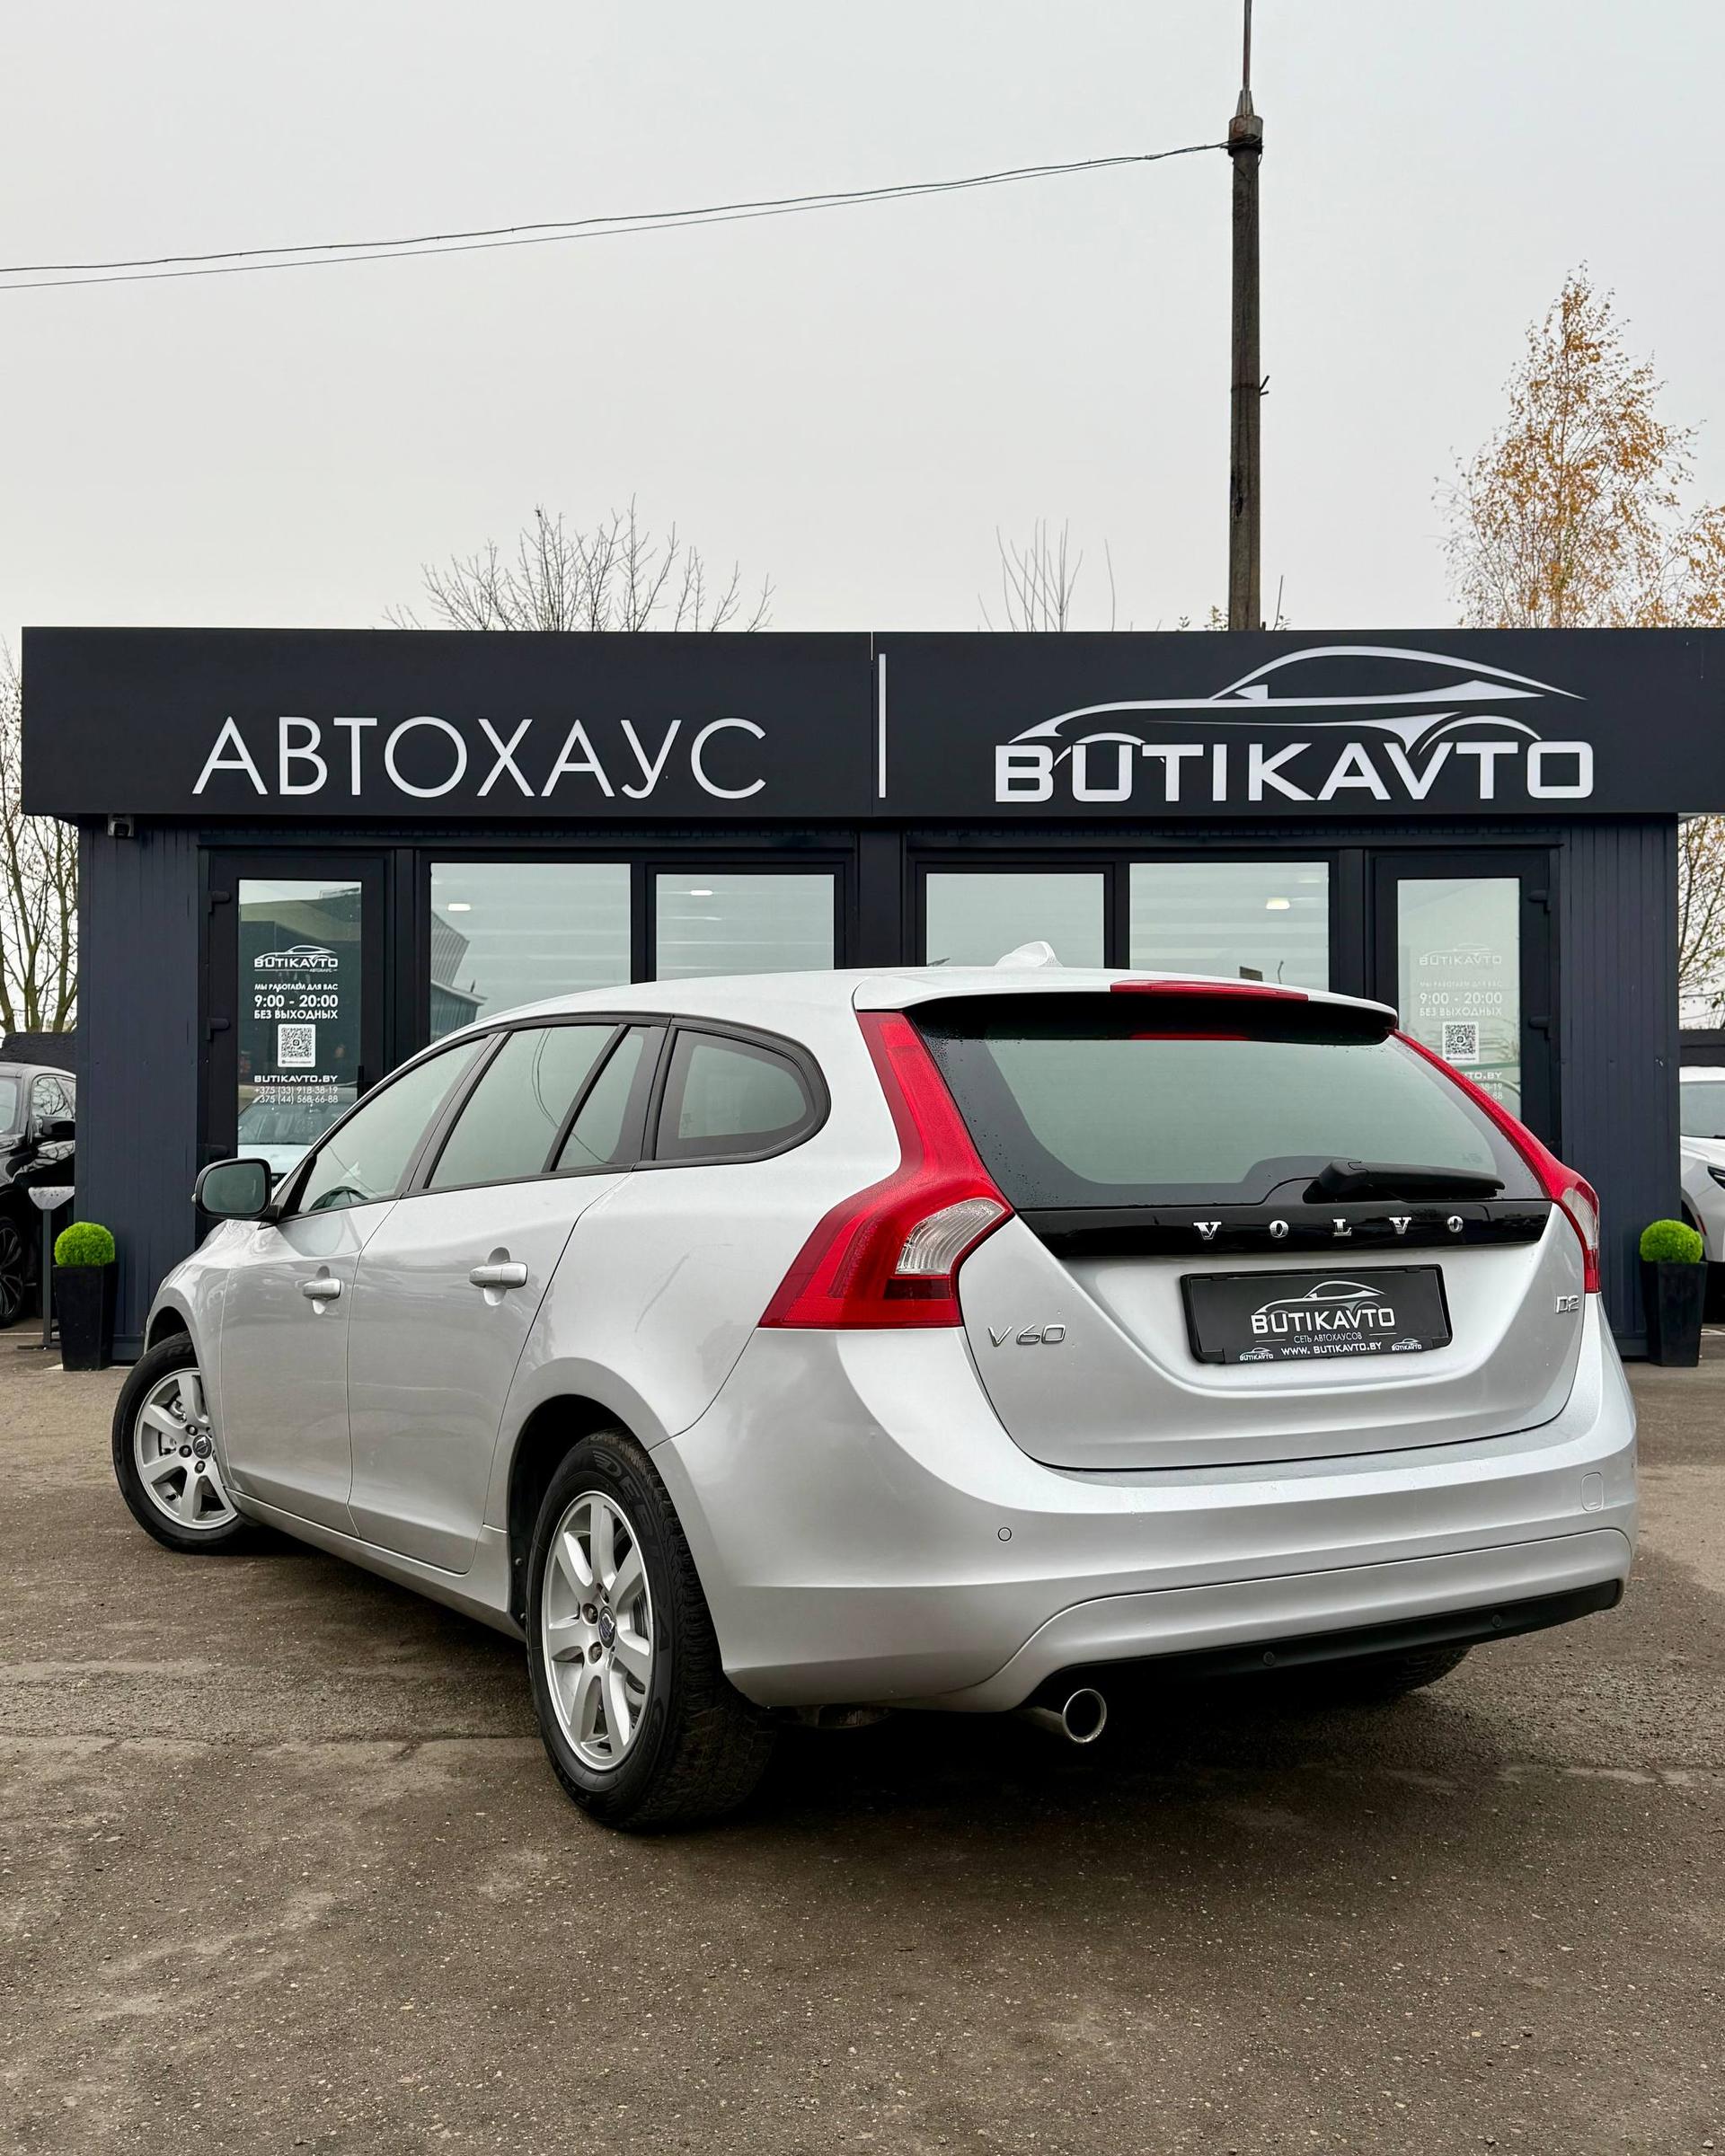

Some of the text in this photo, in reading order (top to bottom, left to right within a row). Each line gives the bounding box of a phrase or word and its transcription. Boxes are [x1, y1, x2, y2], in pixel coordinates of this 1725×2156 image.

[191, 716, 766, 799] АВТОХАУС
[995, 741, 1594, 802] BUTIKAVTO
[254, 959, 339, 968] BUTIKAVTO
[1420, 956, 1502, 966] BUTIKAVTO
[254, 994, 284, 1007] 9:00
[299, 994, 338, 1007] 20:00
[1420, 992, 1448, 1004] 9:00
[1464, 992, 1502, 1004] 20:00
[254, 1010, 338, 1020] БЕЗ ВЫХОДНЫХ
[1420, 1007, 1502, 1016] БЕЗ ВЫХОДНЫХ
[255, 1086, 338, 1095] +375 (33) 918-38-19
[278, 1095, 294, 1104] (44)
[296, 1095, 338, 1103] 568-66-88
[1193, 1215, 1464, 1241] VOLVO
[1555, 1295, 1579, 1313] D2
[1251, 1308, 1394, 1334] BUTIKAVTO
[988, 1324, 1066, 1347] V60
[1294, 1332, 1362, 1344] СЕТЬ АВТОХАУСОВ
[1281, 1342, 1382, 1356] WWW. BUTIKAVTO.BY
[1240, 1353, 1273, 1361] BUTIKAVTO
